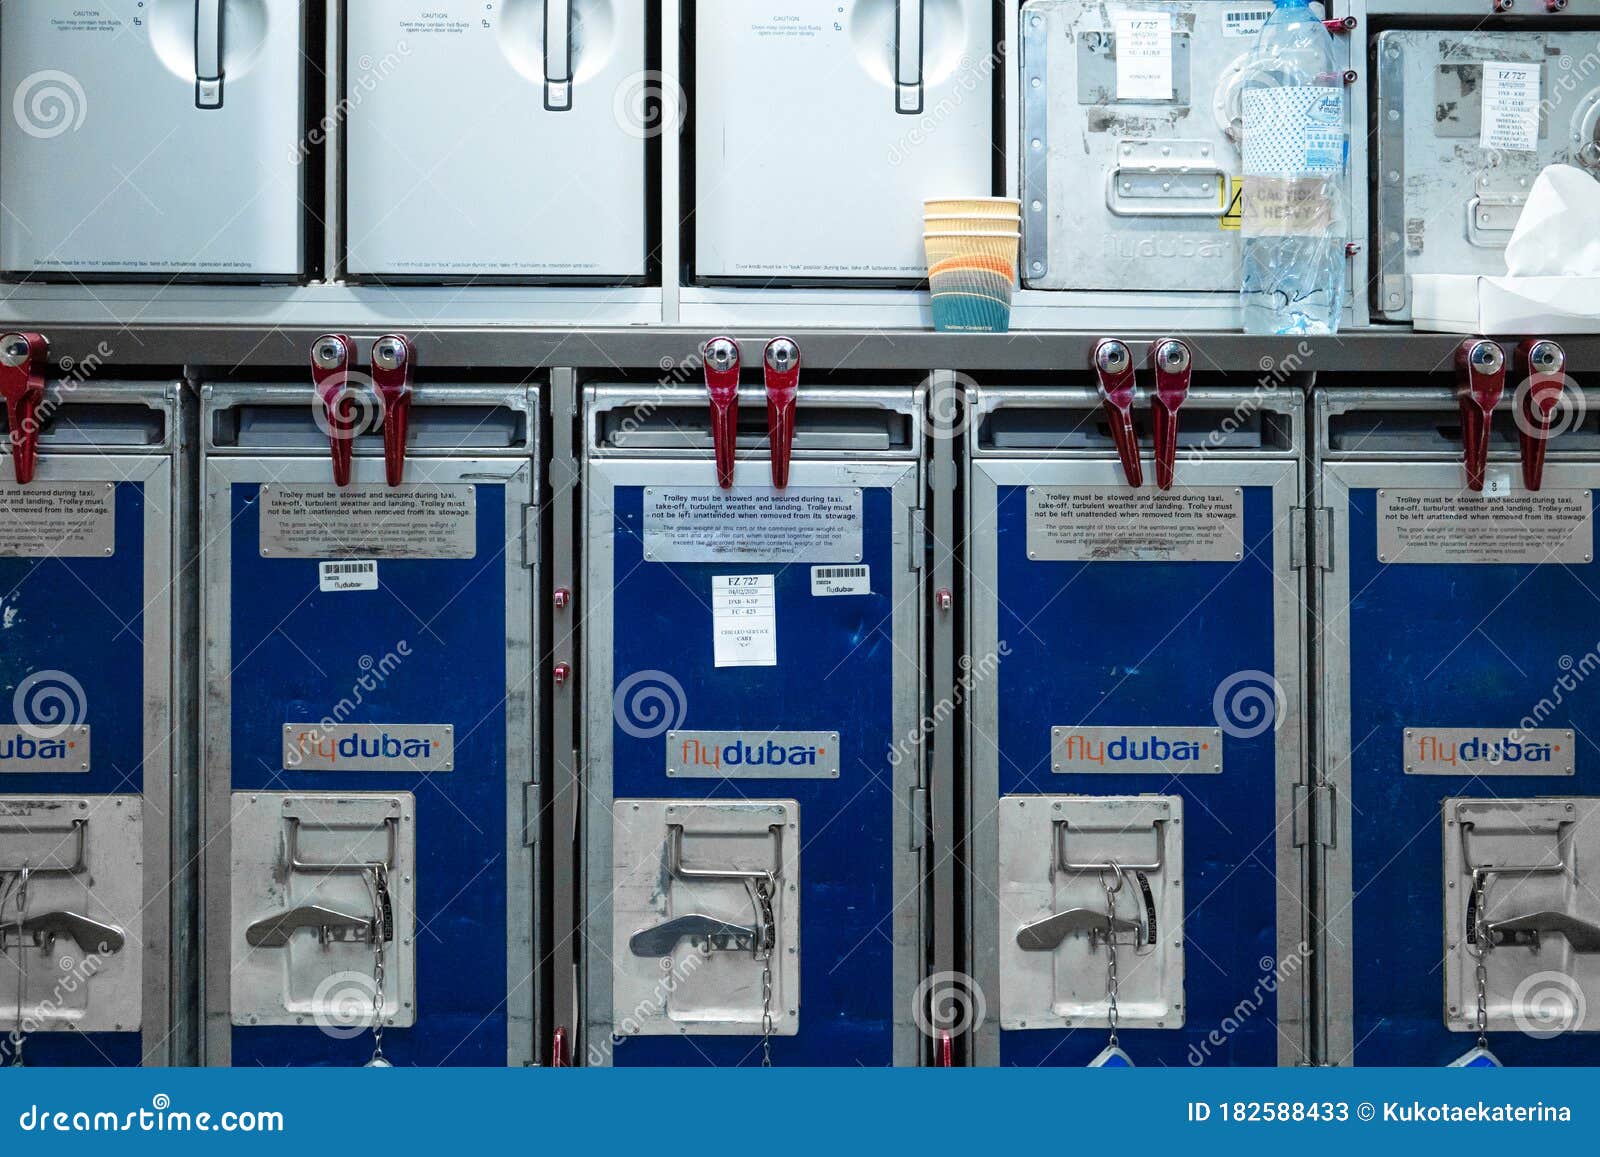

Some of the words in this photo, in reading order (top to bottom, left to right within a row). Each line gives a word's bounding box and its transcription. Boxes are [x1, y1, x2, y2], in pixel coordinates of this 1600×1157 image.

[279, 492, 303, 500] Trolley
[415, 492, 438, 500] during
[663, 494, 688, 503] Trolley
[801, 495, 825, 504] during
[1046, 494, 1070, 502] Trolley
[1183, 494, 1206, 503] during
[421, 500, 445, 509] Trolley
[1397, 497, 1421, 505] Trolley
[1533, 497, 1556, 505] during
[807, 504, 832, 512] Trolley
[1188, 503, 1212, 511] Trolley
[728, 578, 740, 586] FZ
[742, 577, 758, 586] 727
[297, 732, 439, 762] flydubai
[1066, 736, 1208, 766] flydubai
[1418, 736, 1560, 766] flydubai
[682, 740, 825, 769] flydubai
[1148, 907, 1156, 942] CLOSED
